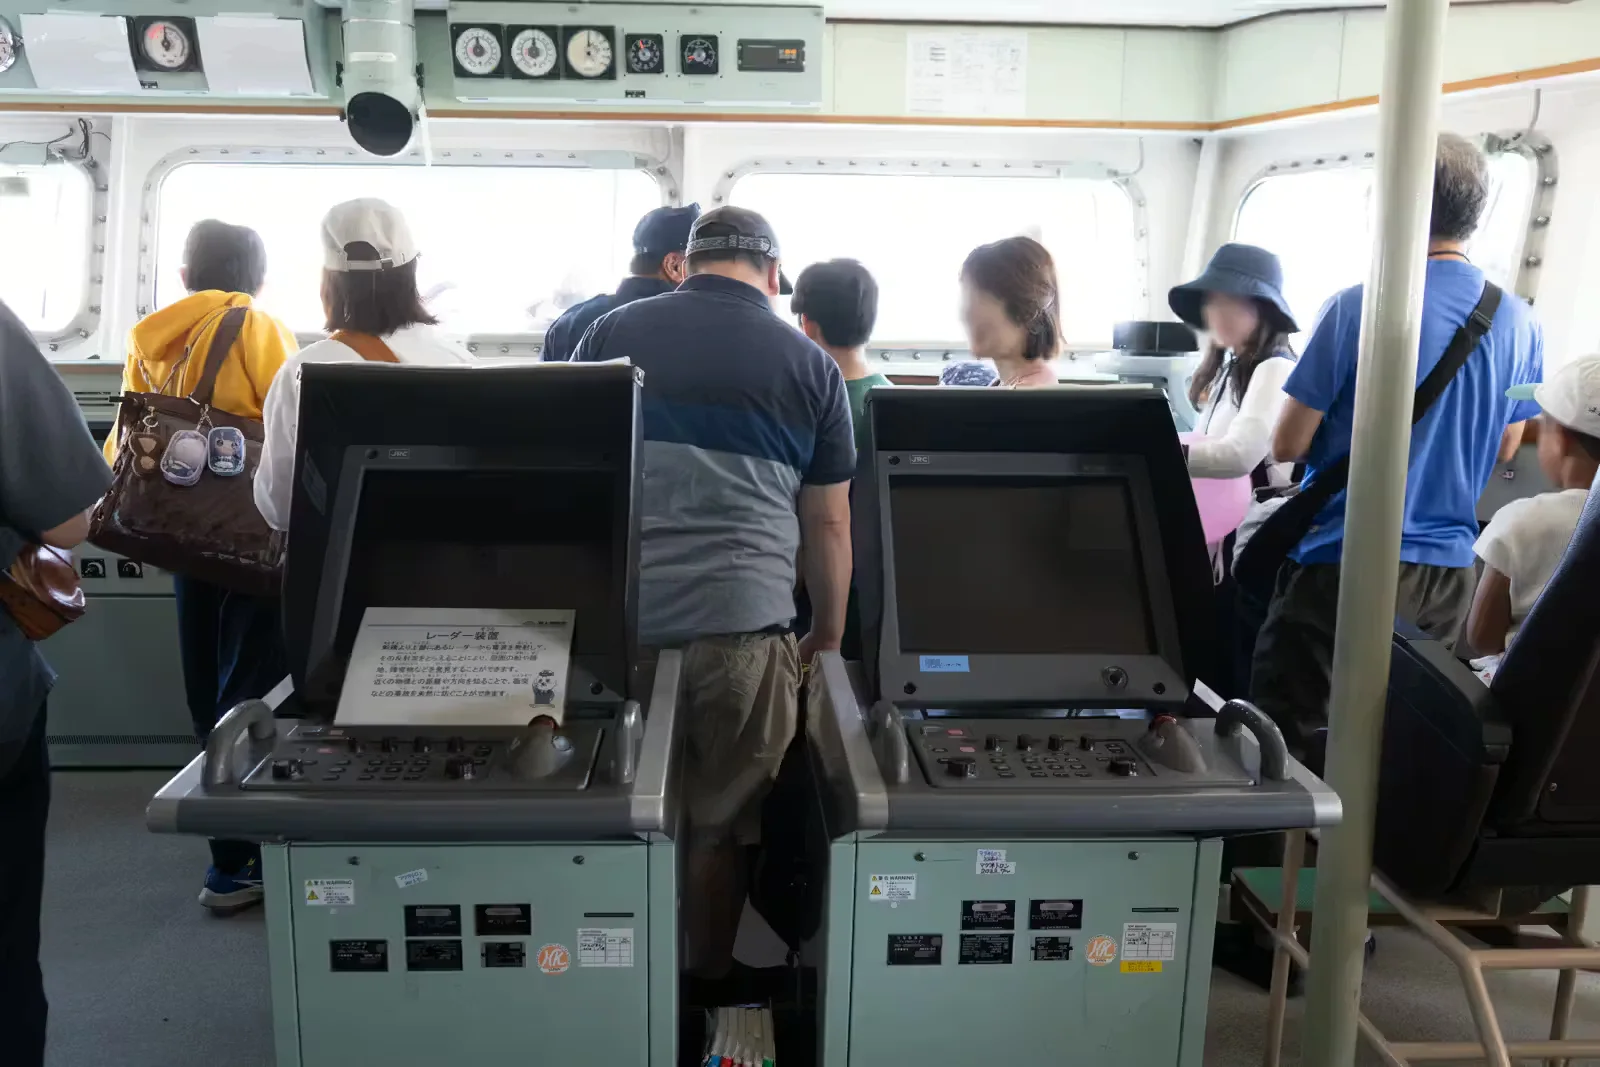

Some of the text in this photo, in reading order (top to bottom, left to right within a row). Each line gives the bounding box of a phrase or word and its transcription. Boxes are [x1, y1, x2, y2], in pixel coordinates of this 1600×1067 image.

[390, 449, 409, 458] JRC
[911, 455, 928, 463] JRC
[426, 631, 499, 641] レーダー装置
